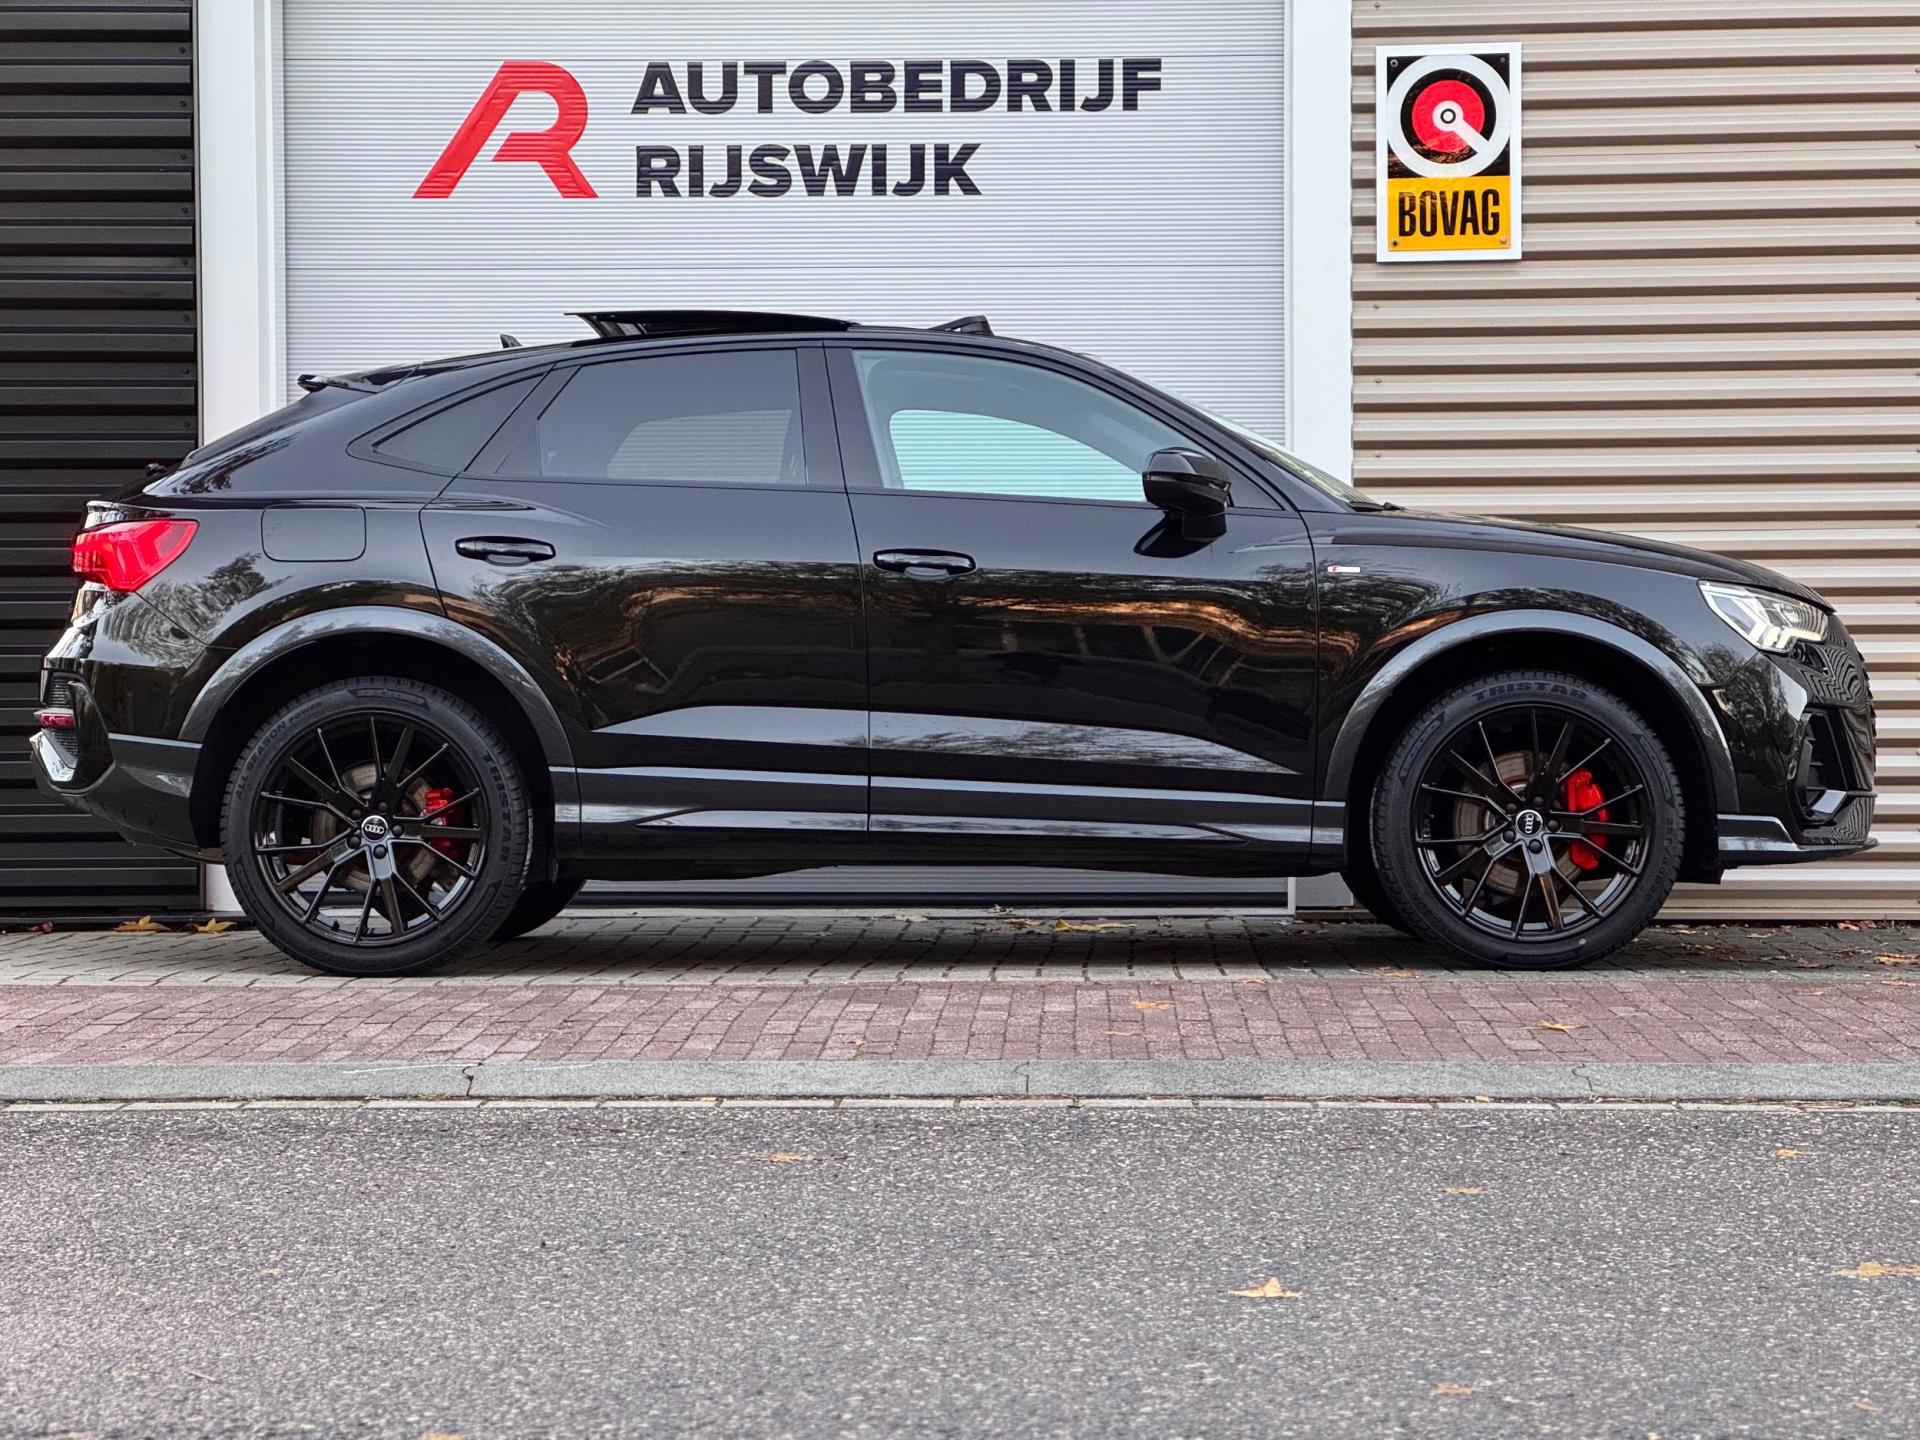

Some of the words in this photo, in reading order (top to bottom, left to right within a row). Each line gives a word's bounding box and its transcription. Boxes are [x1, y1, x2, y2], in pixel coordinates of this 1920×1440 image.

[631, 58, 1162, 115] AUTOBEDRIJF
[635, 143, 983, 197] RIJSWIJK
[1398, 188, 1500, 237] BOVAG
[1471, 682, 1588, 701] TRISTAR
[247, 721, 286, 772] SEASON
[483, 750, 512, 862] TRISTAR
